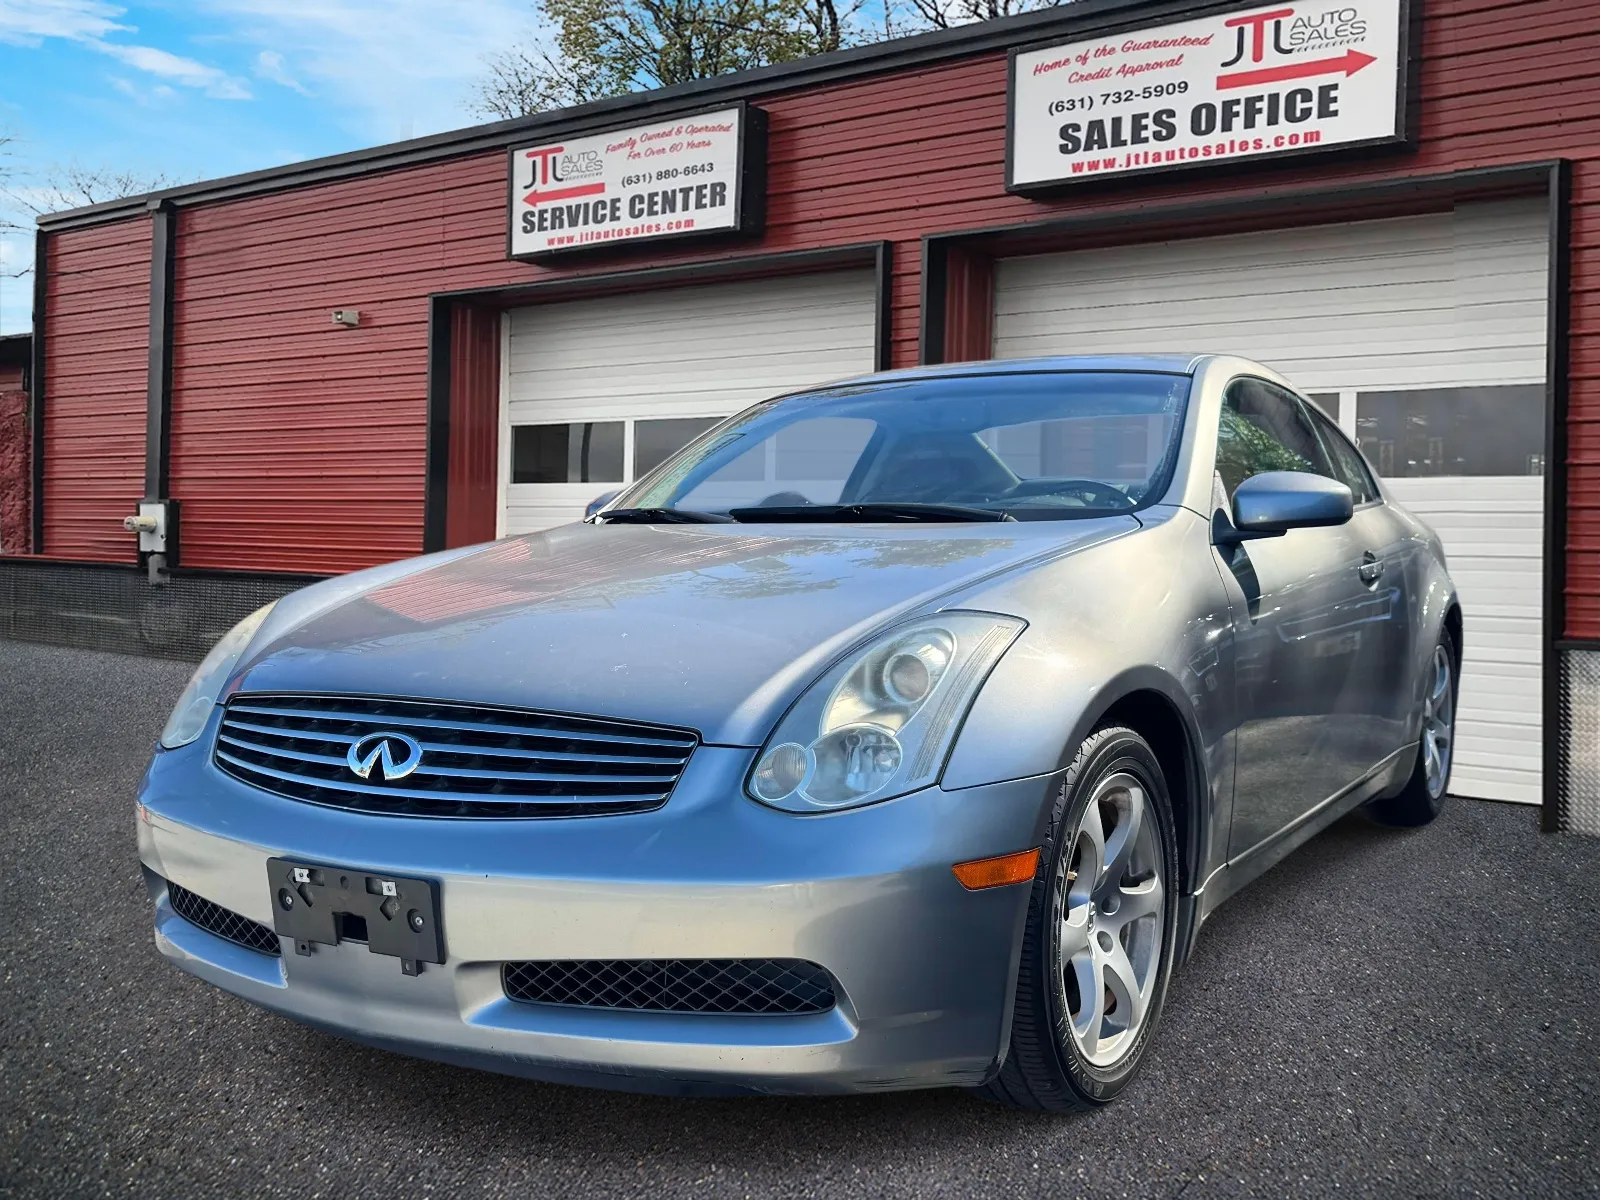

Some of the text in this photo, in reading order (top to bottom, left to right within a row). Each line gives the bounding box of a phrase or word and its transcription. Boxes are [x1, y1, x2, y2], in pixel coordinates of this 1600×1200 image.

[1289, 20, 1367, 46] SALES
[1290, 8, 1357, 31] AUTO
[1033, 33, 1214, 76] Home of the Guaranteed
[1068, 54, 1184, 84] Credit Approval
[1048, 81, 1188, 116] (631) 732-5909
[1058, 83, 1339, 155] SALES OFFICE
[606, 123, 733, 153] Family Owned & Operated
[627, 139, 712, 160] For Over 60 Years
[1071, 130, 1321, 173] www.jtlautosales.com
[560, 160, 603, 176] SALES
[561, 150, 598, 165] AUTO
[621, 162, 714, 188] (631) 880-6643
[521, 182, 727, 234] SERVICE CENTER
[547, 219, 695, 246] www.jtlautosales.com
